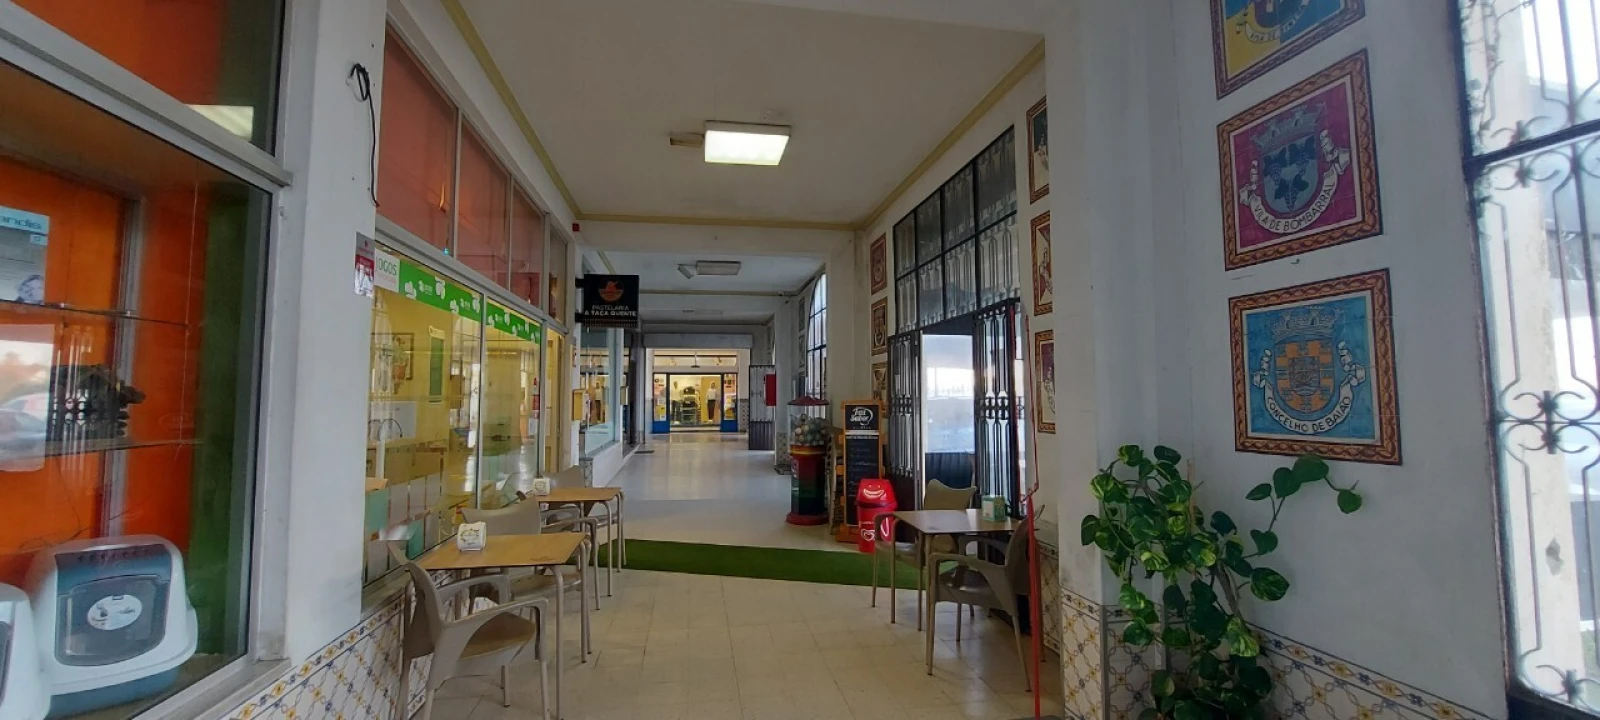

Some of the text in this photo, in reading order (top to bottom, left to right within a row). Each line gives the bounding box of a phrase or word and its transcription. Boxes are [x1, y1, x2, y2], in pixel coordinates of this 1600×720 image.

[1255, 184, 1334, 232] VILA DE BOMBARRAL
[1267, 397, 1309, 432] CONCELHO
[1312, 423, 1325, 432] DE
